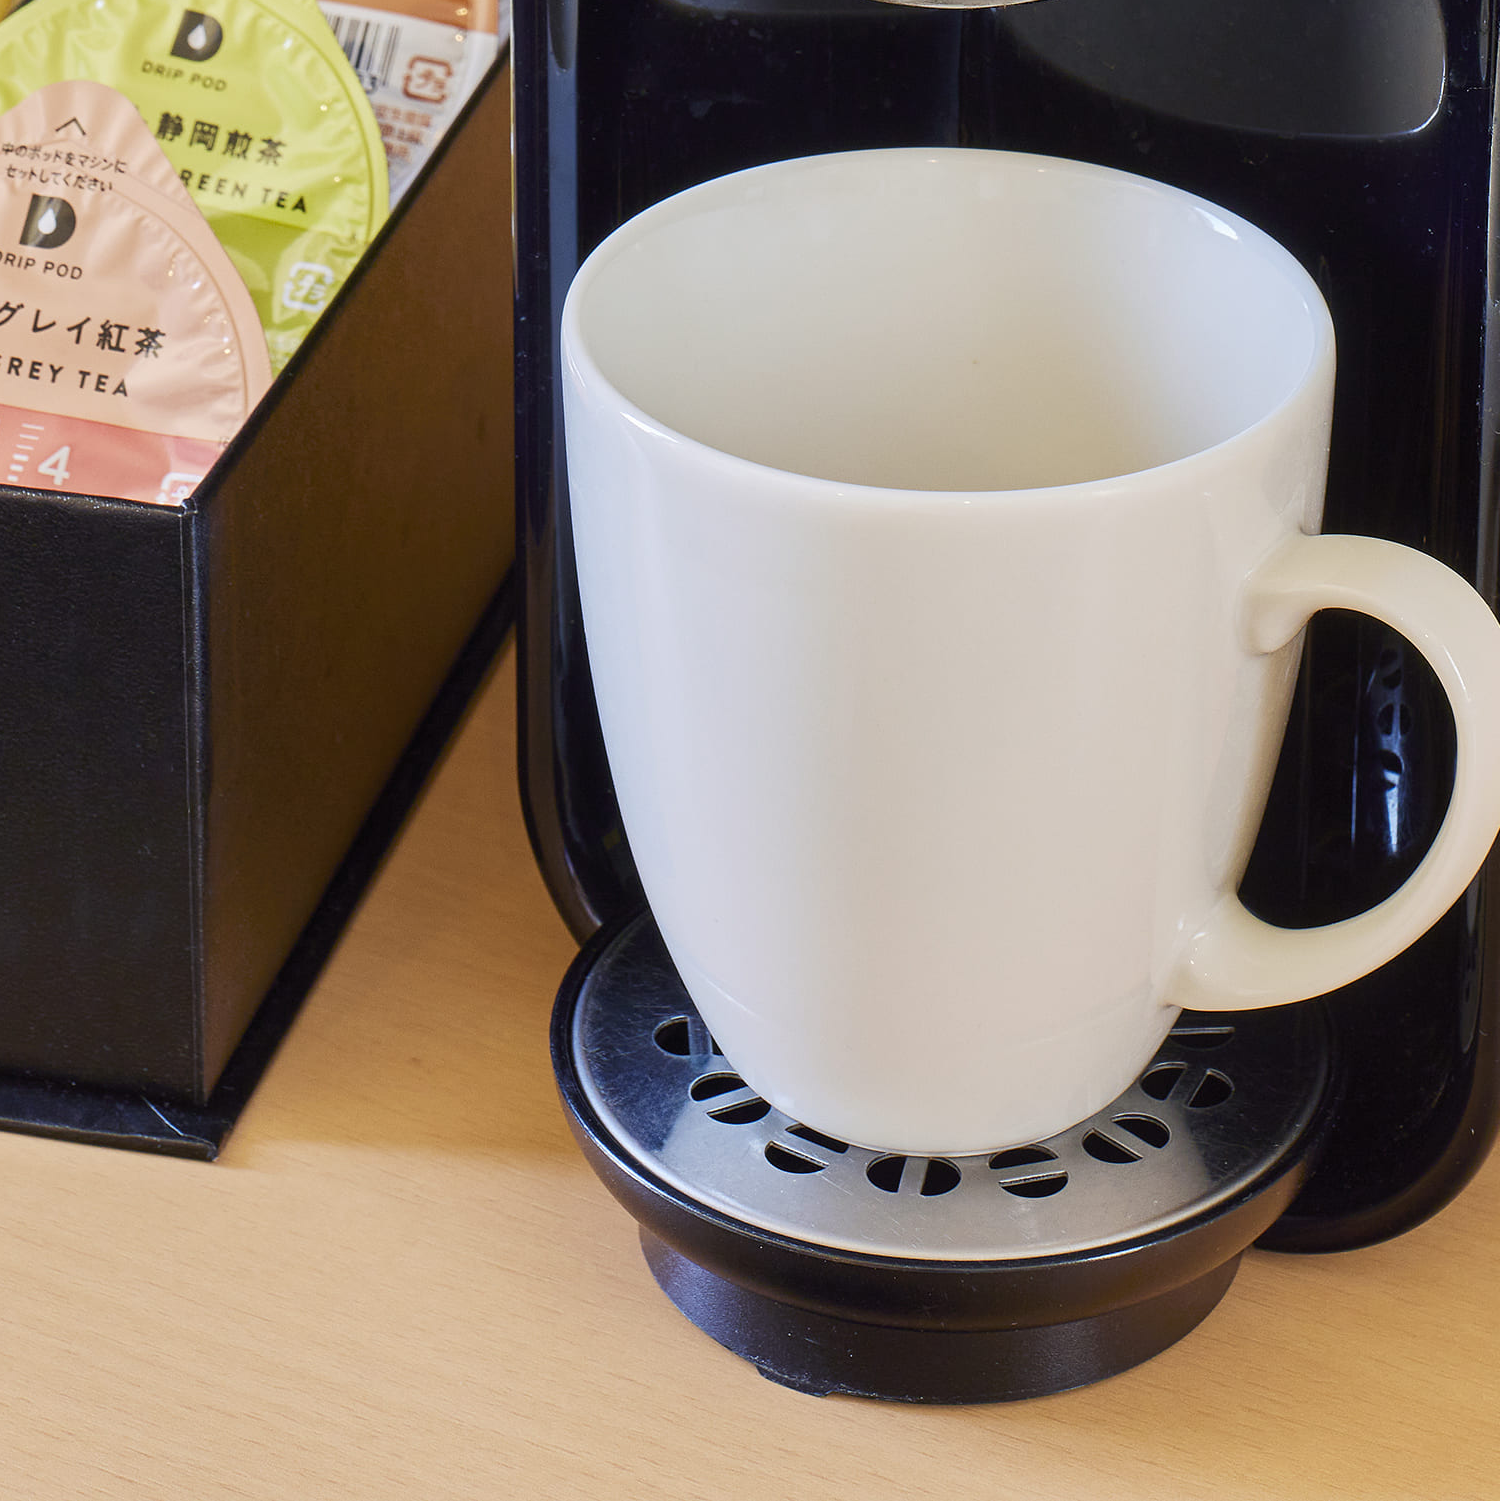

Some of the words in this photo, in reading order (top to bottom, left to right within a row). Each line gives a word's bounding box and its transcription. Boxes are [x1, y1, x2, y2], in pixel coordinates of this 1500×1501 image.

[141, 59, 184, 79] DRIP
[190, 72, 228, 92] POD
[6, 163, 113, 192] セットしてください
[180, 168, 249, 199] REEN
[262, 187, 307, 214] TEA
[43, 260, 83, 281] POD
[78, 370, 129, 398] TEA
[37, 445, 71, 486] 4
